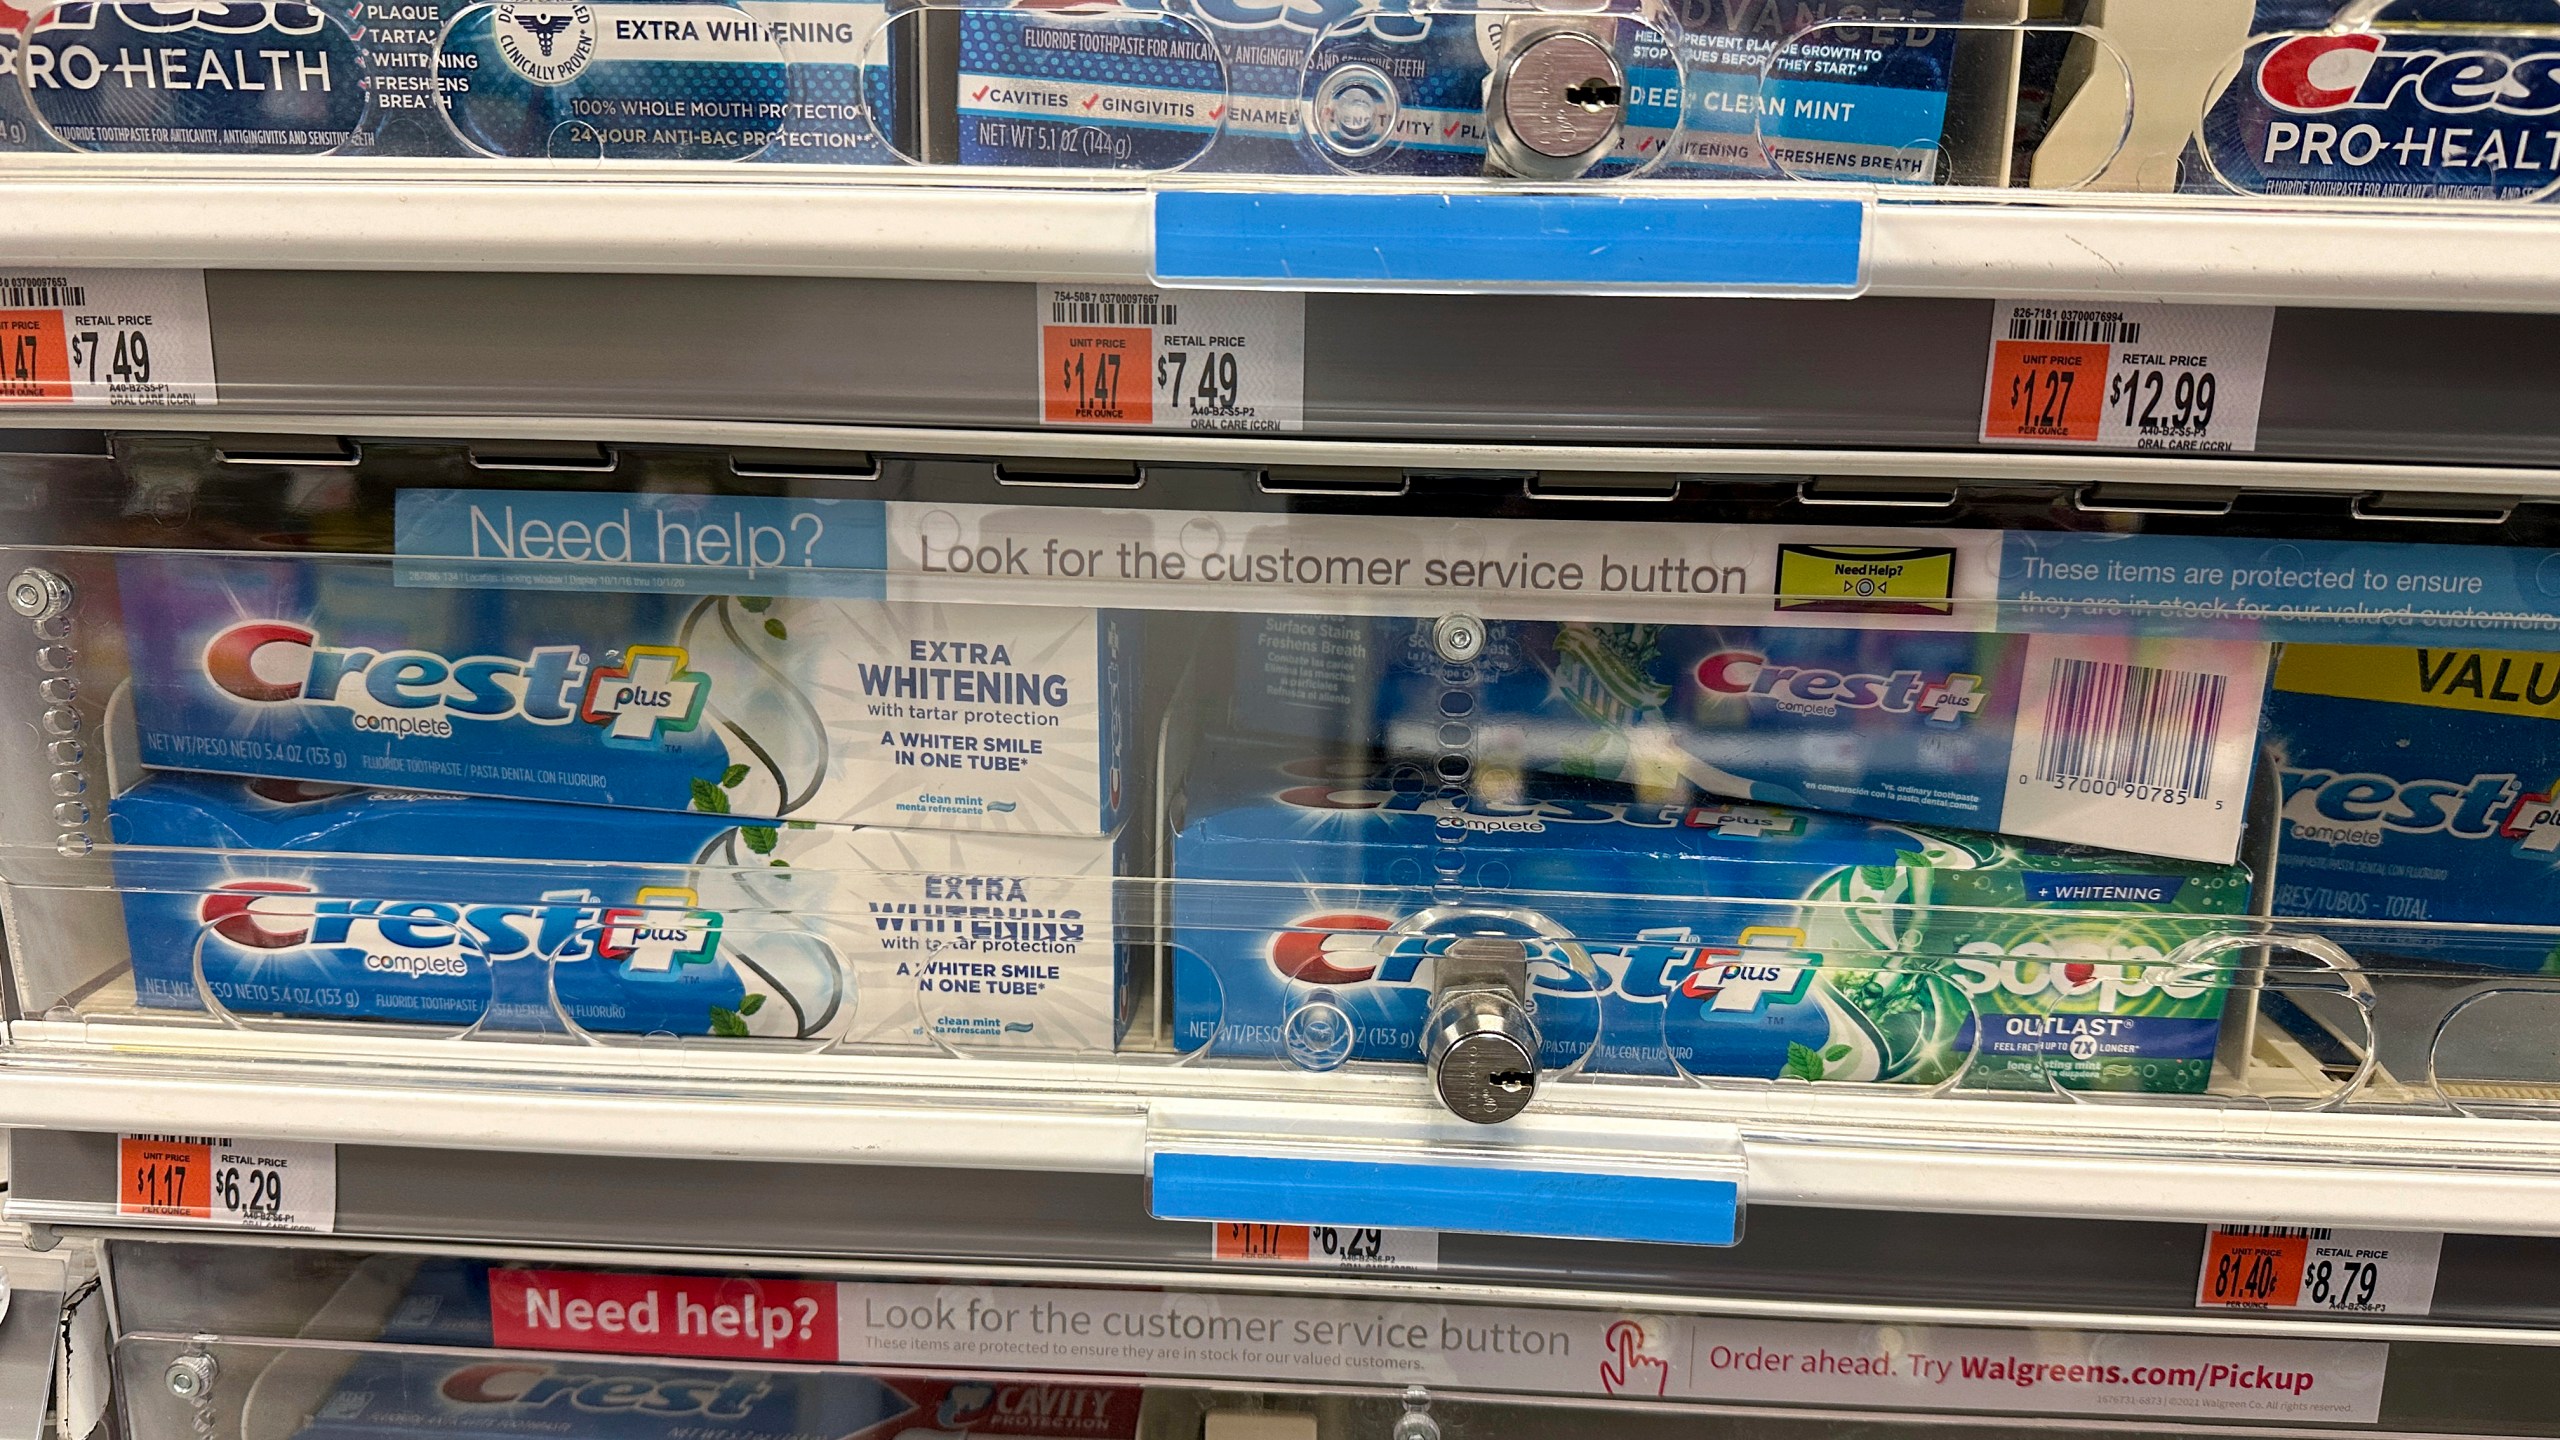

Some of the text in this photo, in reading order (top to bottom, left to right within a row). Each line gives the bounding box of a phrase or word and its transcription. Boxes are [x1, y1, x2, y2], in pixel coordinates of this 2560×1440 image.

[367, 5, 439, 21] PLAQUE
[616, 20, 700, 42] EXTRA
[1684, 33, 1882, 61] PREVENT GROWTH TO
[573, 100, 754, 118] 100% WHOLE MOUTH
[990, 88, 1195, 119] CAVITIES GINGIVITIS
[1704, 91, 1855, 123] CLEAN MINT
[980, 124, 1133, 159] NET WT 5.1 OZ (144 g)
[1775, 149, 1922, 174] FRESHENS BREATH
[12, 321, 40, 330] PRICE
[75, 315, 153, 327] RETAIL PRICE
[1069, 338, 1126, 348] UNIT PRICE
[1164, 336, 1246, 347] RETAIL PRICE
[72, 330, 150, 385] $7.49
[2023, 355, 2082, 366] UNIT PRICE
[2122, 353, 2207, 367] RETAIL PRICE
[1064, 352, 1121, 409] $1.47
[1158, 352, 1238, 409] $7.49
[2011, 370, 2075, 427] $1.27
[2110, 369, 2216, 430] $12.99
[1075, 409, 1124, 418] PER OUNCE
[1191, 407, 1255, 417] A40-B2-S5-P2
[1191, 419, 1247, 430] ORAL CARE
[2018, 426, 2069, 436] PER OUNCE
[2137, 438, 2198, 451] ORAL CARE
[469, 505, 825, 581] Need help?
[920, 535, 1748, 597] Look for the customer service button
[1834, 562, 1904, 579] Need Help?
[2021, 556, 2484, 595] These items are protected to ensure
[1265, 618, 1316, 637] Surface
[1319, 624, 1362, 643] Stains
[910, 639, 1012, 667] EXTRA
[857, 662, 1069, 708] WHITENING
[1696, 649, 1925, 713] Crest
[613, 686, 674, 710] plus
[1776, 699, 1837, 718] complete
[1935, 693, 1971, 709] plus
[352, 712, 454, 740] complete
[867, 702, 1060, 728] with tartar protection
[881, 731, 1043, 755] A WHITER SMILE
[895, 751, 963, 769] IN ONE
[918, 793, 984, 807] clean mint
[1817, 782, 1869, 797] comparación
[1870, 789, 1886, 799] con
[1887, 791, 1895, 800] la
[1896, 792, 1920, 806] pasta
[1920, 796, 1948, 808] dental
[1897, 784, 1980, 804] ordinary toothpaste
[2019, 774, 2223, 811] 0 37000 90785 5
[896, 803, 984, 816] menta refrescante
[2292, 824, 2382, 847] complete
[925, 875, 1028, 902] EXTRA
[2054, 885, 2162, 901] WHITENING
[868, 902, 1084, 942] WHITENING
[631, 925, 688, 945] plus
[881, 936, 1076, 955] with protection
[366, 953, 469, 980] complete
[896, 962, 910, 976] A
[1001, 965, 1060, 980] SMILE
[1715, 962, 1782, 986] plus
[939, 979, 981, 995] ONE
[937, 1016, 1001, 1029] clean mint
[143, 1151, 191, 1163] UNIT PRICE
[221, 1154, 288, 1168] RETAIL PRICE
[138, 1163, 186, 1207] $1.17
[216, 1166, 281, 1214] $6.29
[2231, 1247, 2282, 1257] UNIT PRICE
[2316, 1247, 2389, 1260] RETAIL PRICE
[2215, 1253, 2278, 1300] 81.40¢
[2304, 1260, 2378, 1307] $8.79
[525, 1286, 820, 1349] Need help?
[865, 1296, 1571, 1357] Look for the customer service button
[865, 1336, 1425, 1371] These items are protected to ensure they are in stock for our valued customers.
[1709, 1344, 2315, 1396] Order ahead. Try Walgreens.com/Pickup
[999, 1384, 1114, 1416] CAVITY
[990, 1413, 1111, 1430] PROTECTION
